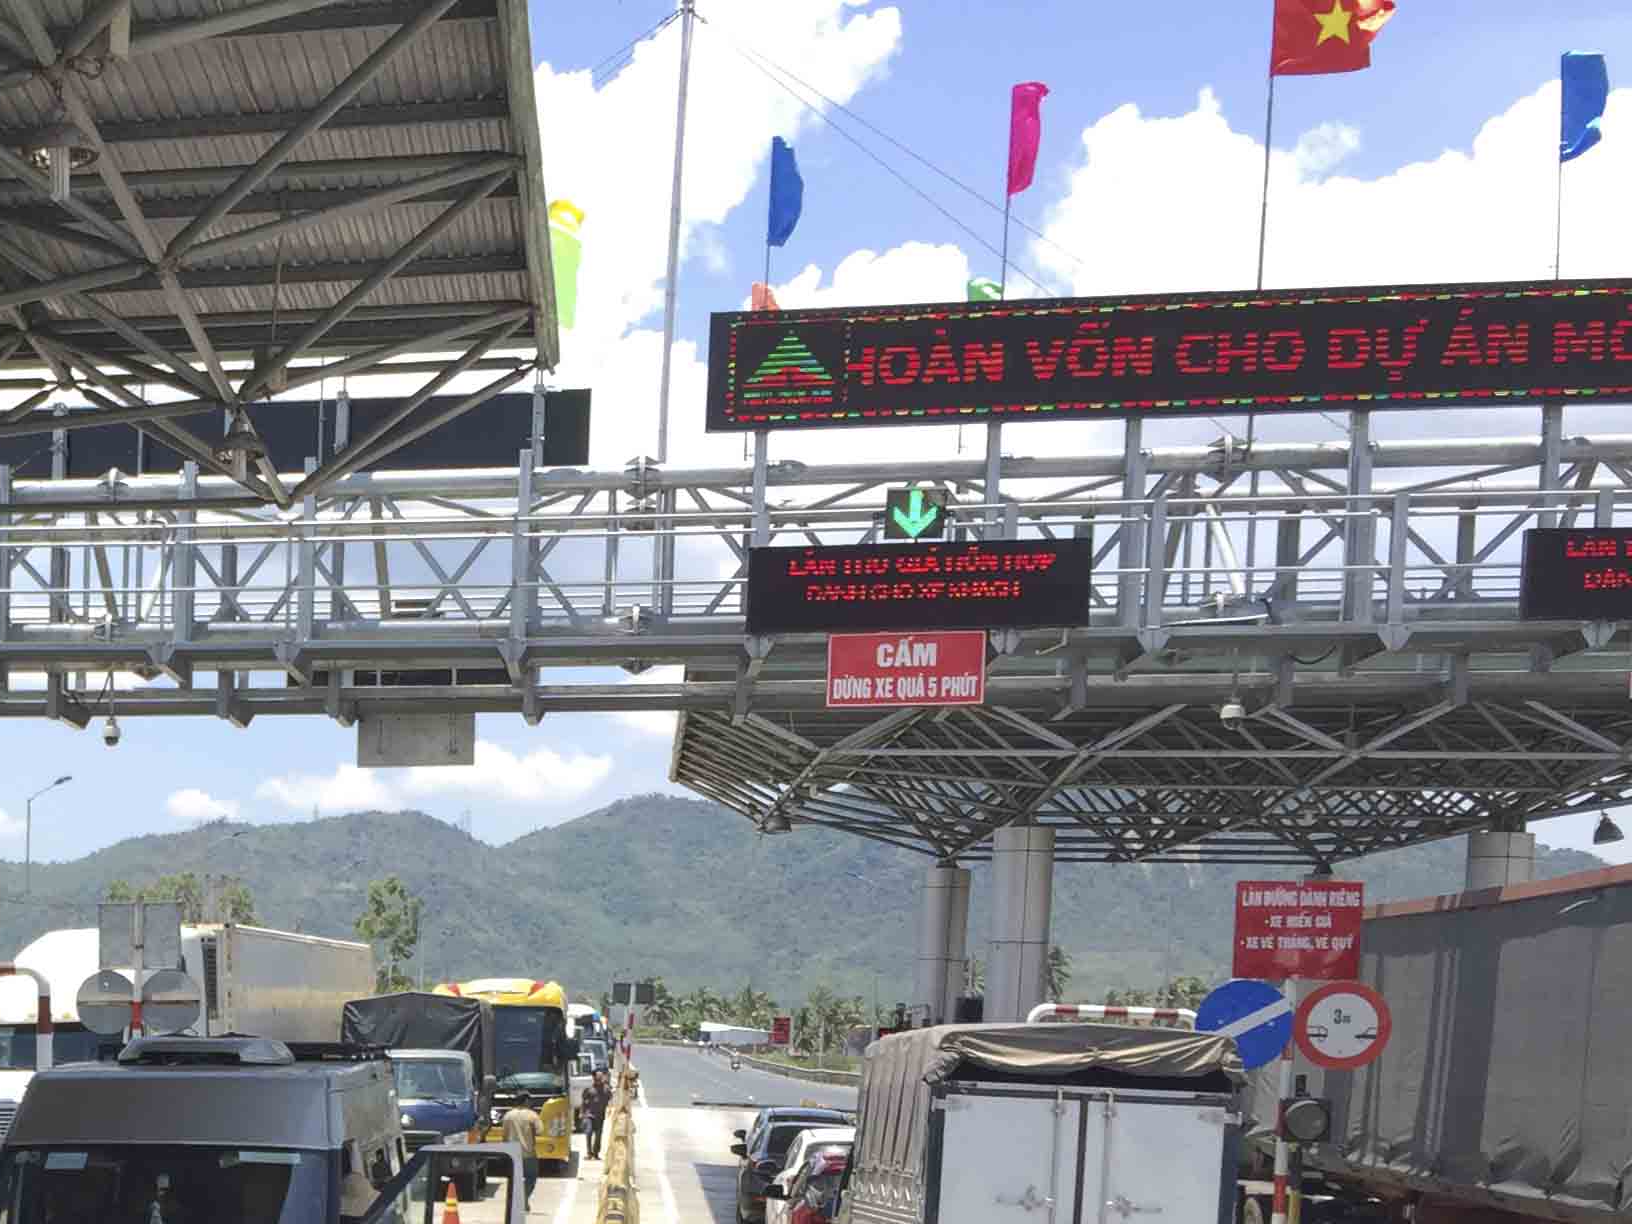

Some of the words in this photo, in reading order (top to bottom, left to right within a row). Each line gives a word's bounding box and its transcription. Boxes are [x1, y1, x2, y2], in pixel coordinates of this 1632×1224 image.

[1025, 320, 1156, 380] VỐN
[1175, 330, 1306, 374] CHO
[1441, 307, 1530, 366] ÁN
[876, 636, 938, 667] CẤM
[875, 678, 895, 699] XE
[896, 672, 926, 698] QUÁ
[927, 676, 938, 697] 5
[942, 671, 978, 697] PHÚT
